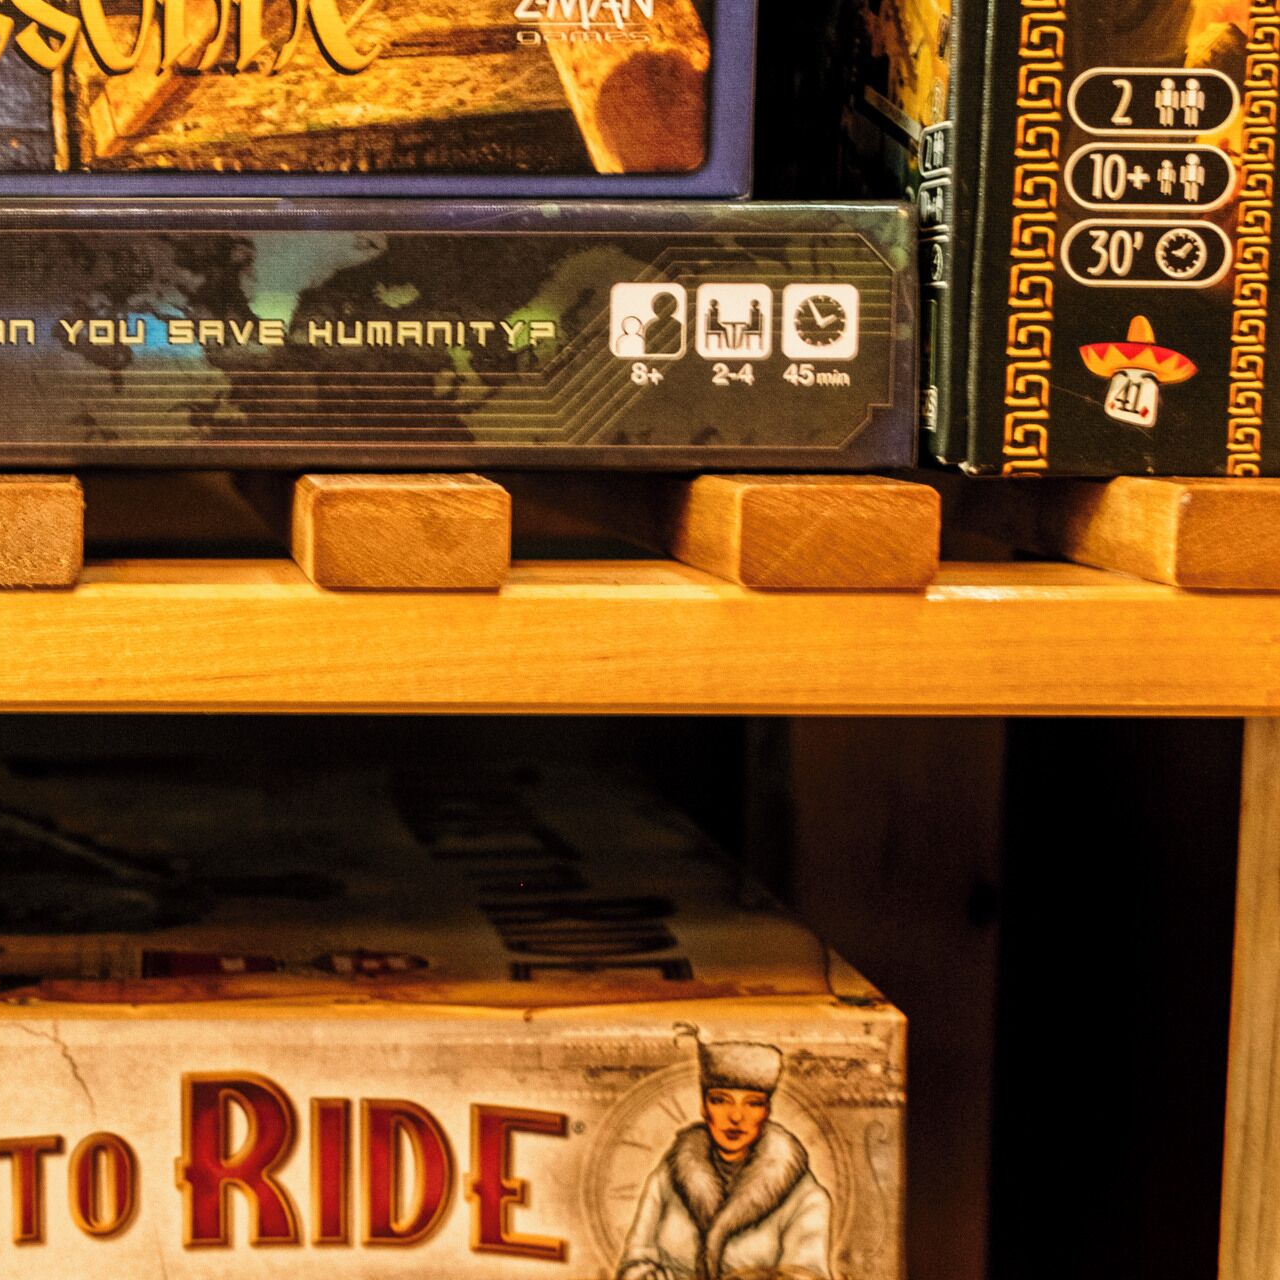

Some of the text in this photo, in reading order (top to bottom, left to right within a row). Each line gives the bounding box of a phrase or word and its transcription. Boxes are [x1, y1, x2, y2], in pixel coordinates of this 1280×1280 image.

[515, 30, 652, 46] games
[1111, 77, 1133, 126] 2
[1090, 152, 1151, 200] 10+
[59, 319, 149, 348] YOU
[168, 319, 287, 348] SAVE
[308, 320, 558, 349] HUMANITY?
[629, 361, 664, 388] 8+
[710, 362, 755, 388] 2-4
[782, 363, 851, 387] 45 min
[175, 1070, 571, 1263] RIDE
